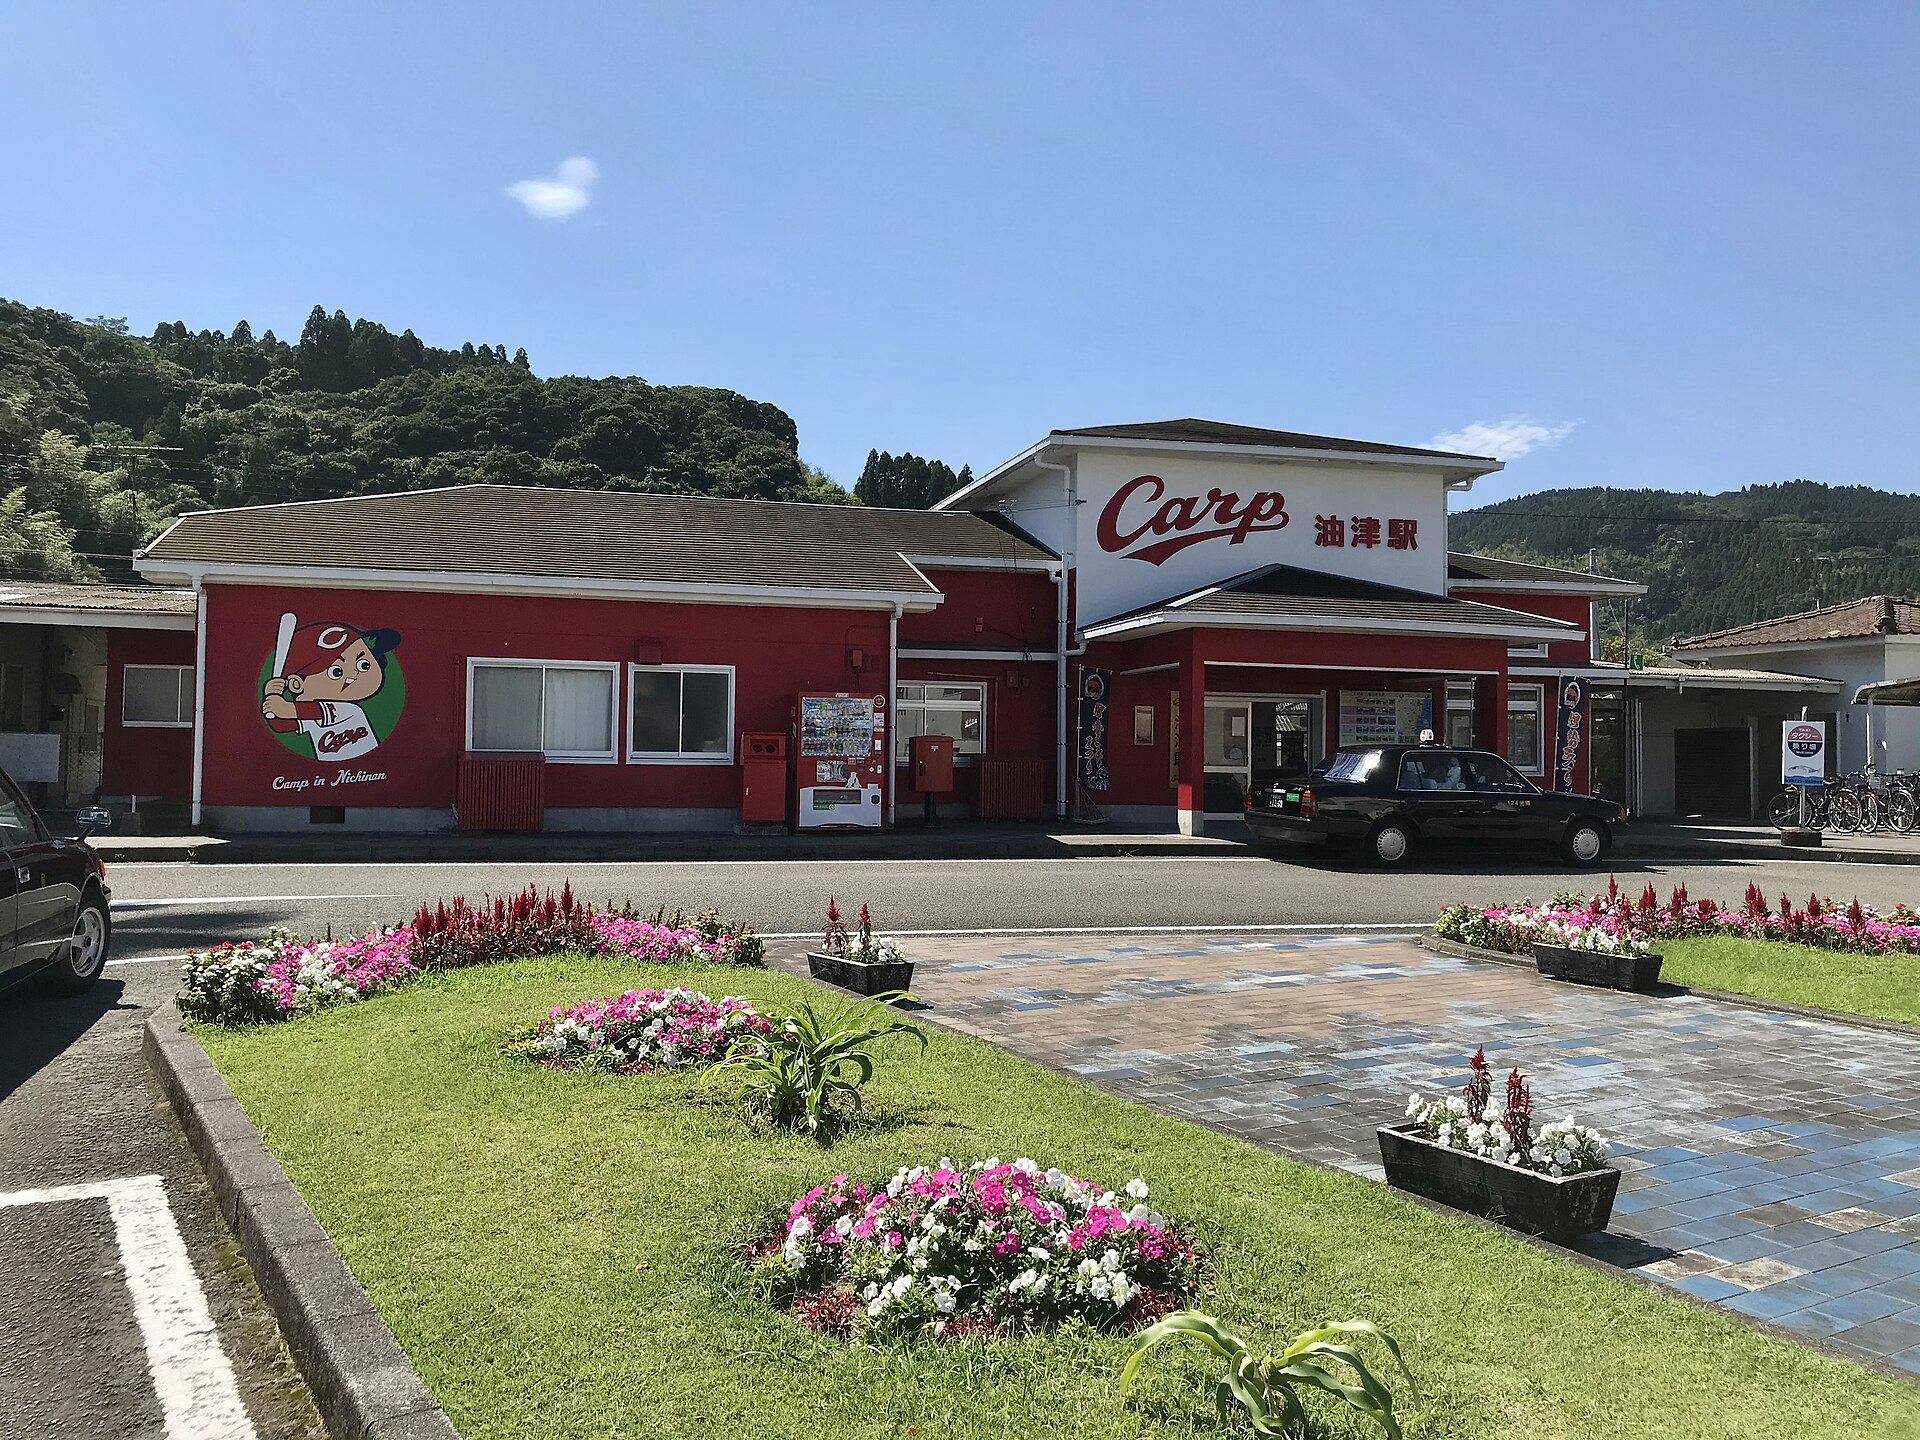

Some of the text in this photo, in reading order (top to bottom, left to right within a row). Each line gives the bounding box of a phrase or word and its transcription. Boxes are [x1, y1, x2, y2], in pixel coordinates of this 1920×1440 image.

[1096, 475, 1290, 567] Carp
[1314, 514, 1418, 551] 油津駅
[1792, 742, 1817, 750] 乗り場
[271, 769, 388, 792] Camp in Nichinan
